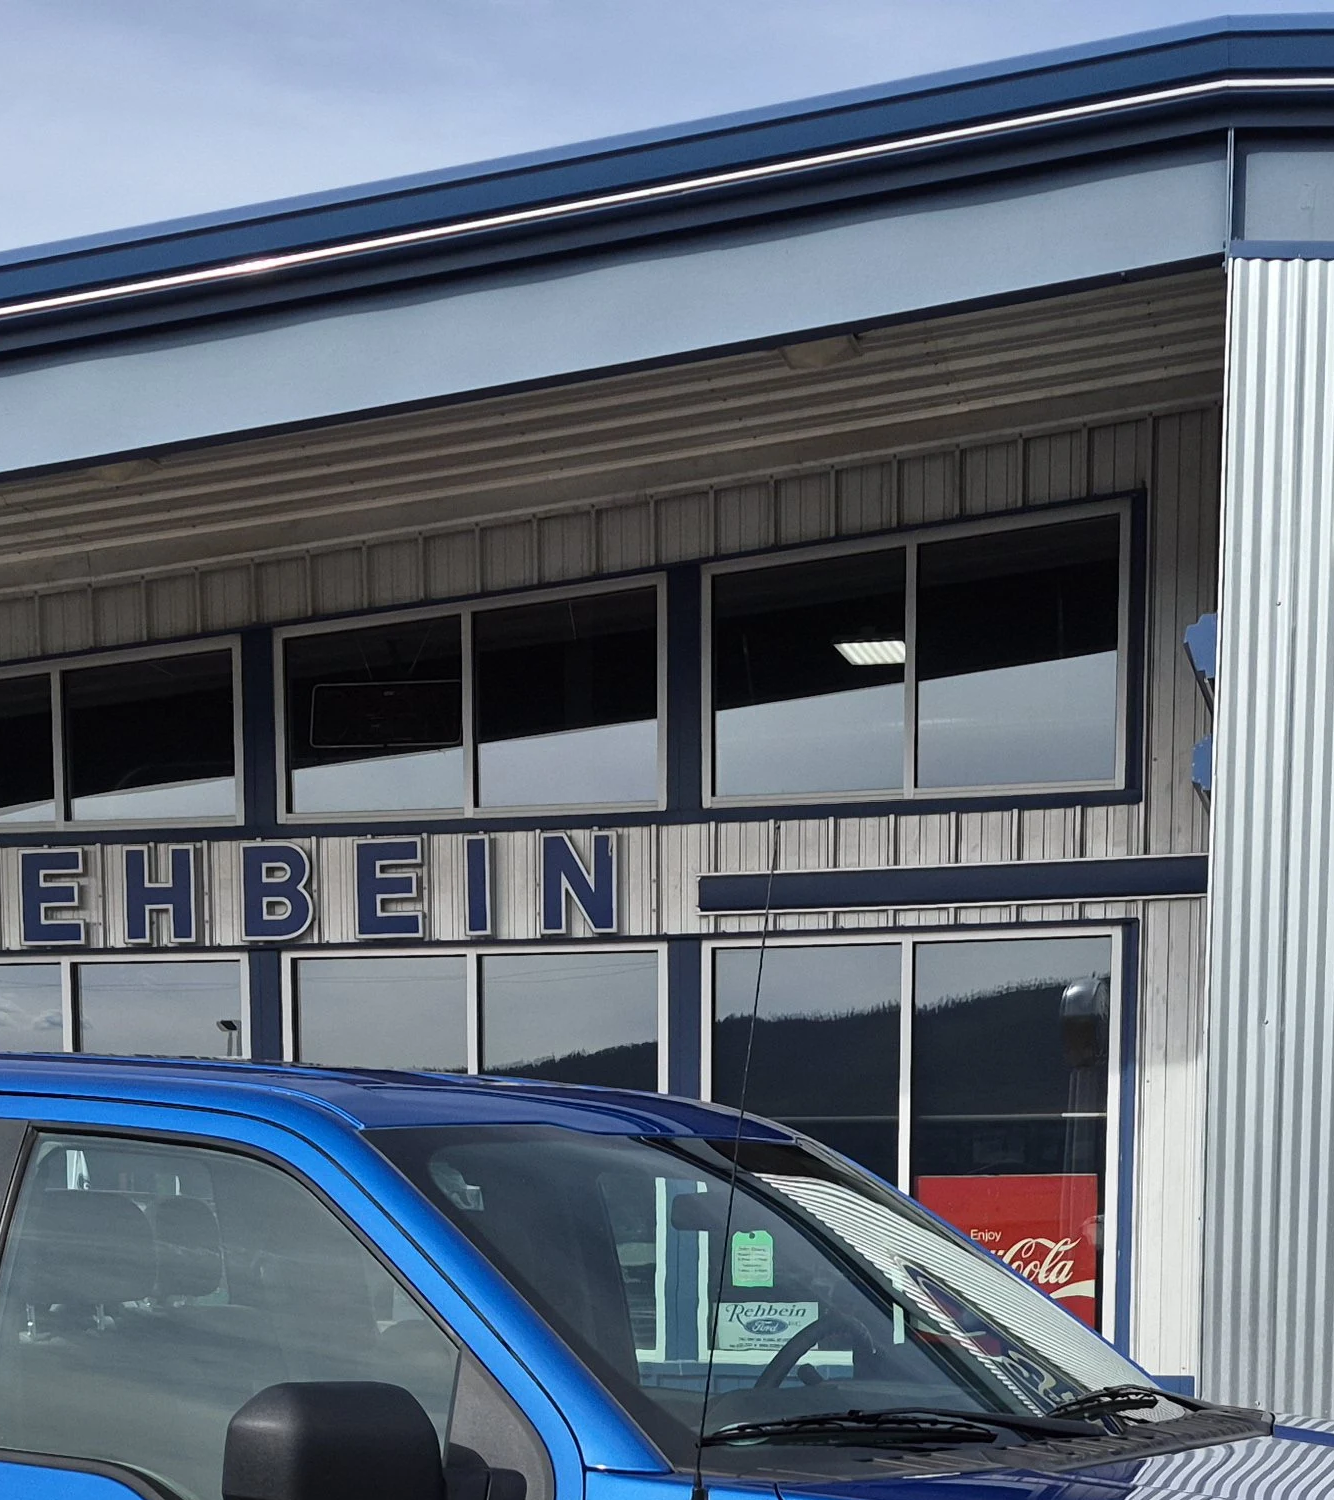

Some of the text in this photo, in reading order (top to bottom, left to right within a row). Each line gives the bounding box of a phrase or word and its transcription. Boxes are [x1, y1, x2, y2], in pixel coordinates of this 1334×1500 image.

[970, 1229, 1002, 1243] Enjoy
[725, 1304, 807, 1326] Rehbein
[751, 1321, 779, 1332] Ford
